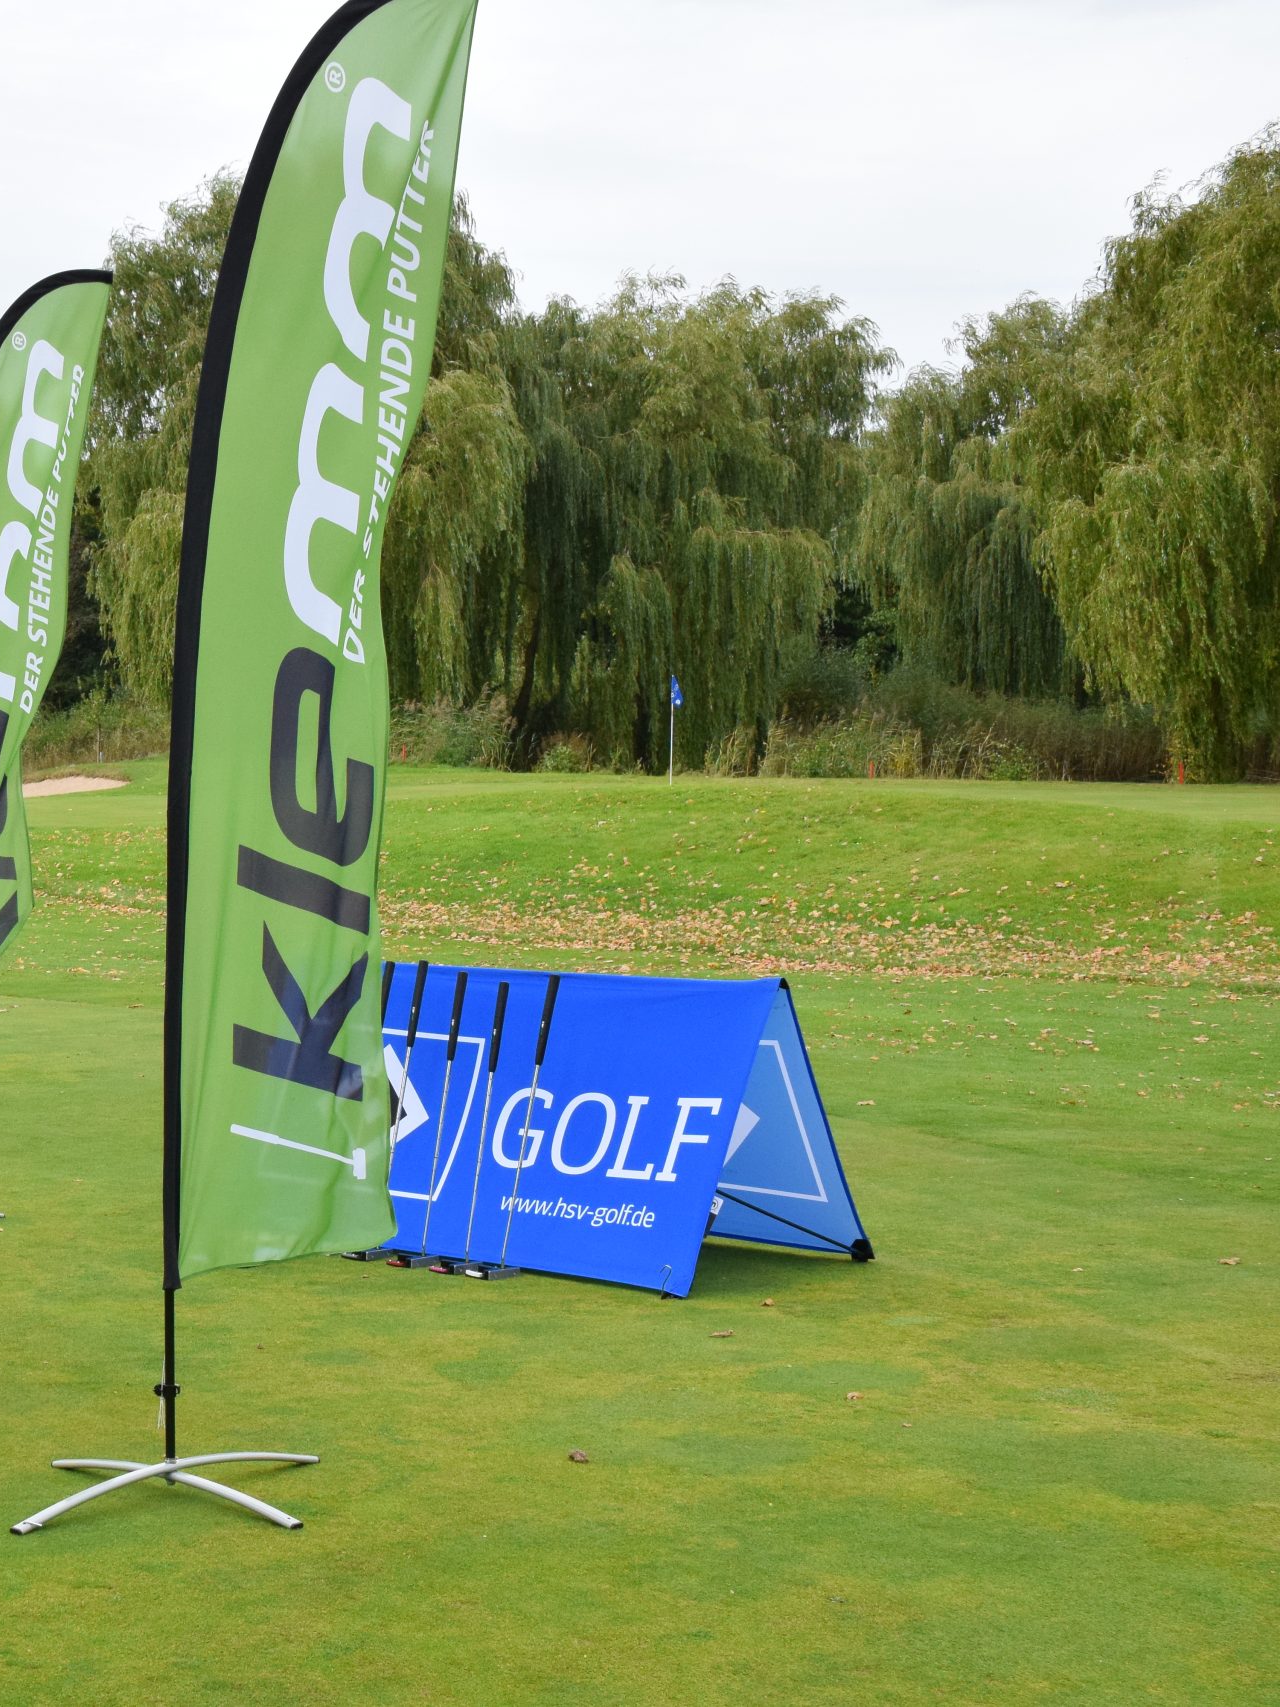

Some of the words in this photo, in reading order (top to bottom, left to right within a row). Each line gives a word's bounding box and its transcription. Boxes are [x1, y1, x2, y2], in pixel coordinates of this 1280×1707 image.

[387, 120, 434, 303] PUTTER
[363, 309, 415, 560] STEHENDE
[28, 485, 59, 647] STEHENDE
[343, 569, 366, 664] DER
[20, 652, 43, 714] DER
[492, 1087, 722, 1182] GOLF
[500, 1195, 655, 1228] www.hsv-golf.de
